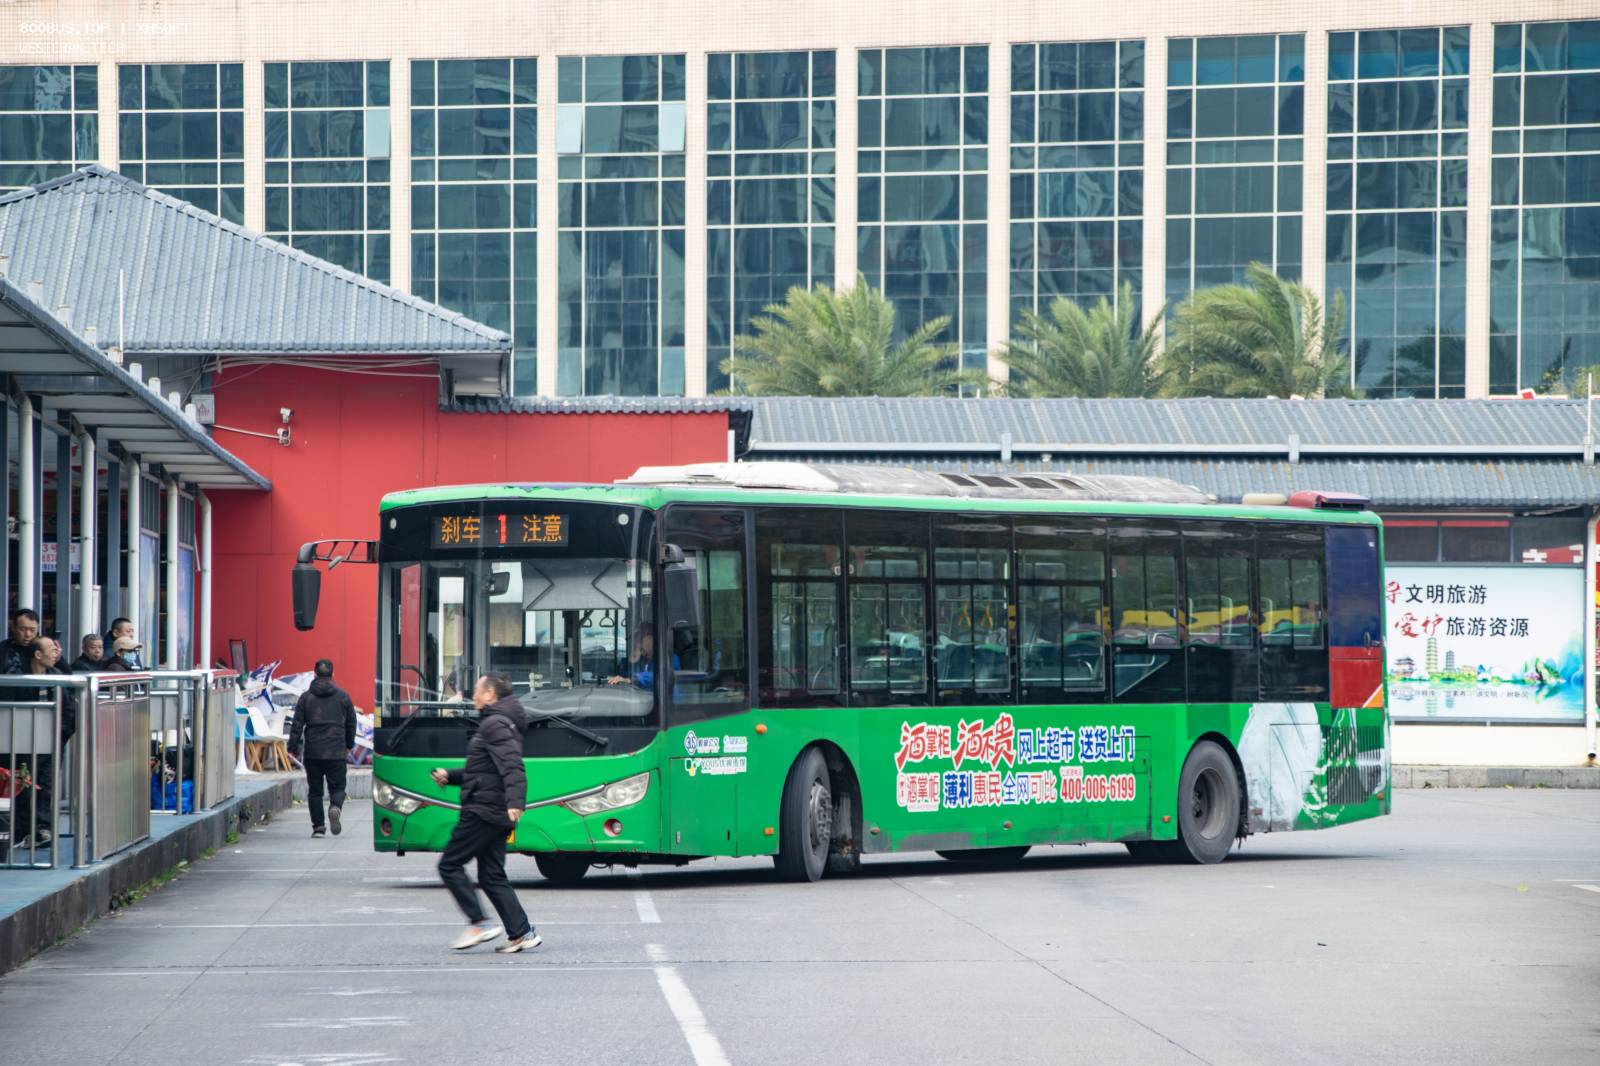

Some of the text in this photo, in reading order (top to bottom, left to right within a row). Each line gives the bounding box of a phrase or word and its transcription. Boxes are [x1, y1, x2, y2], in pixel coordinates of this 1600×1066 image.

[441, 513, 563, 544] 刹车 1 注意
[1394, 611, 1530, 638] 爱护旅游资源
[896, 723, 951, 770] 酒掌柜
[1018, 729, 1074, 762] 网上超市
[1079, 728, 1135, 761] 送货上门
[1061, 776, 1135, 801] 400-006-6199
